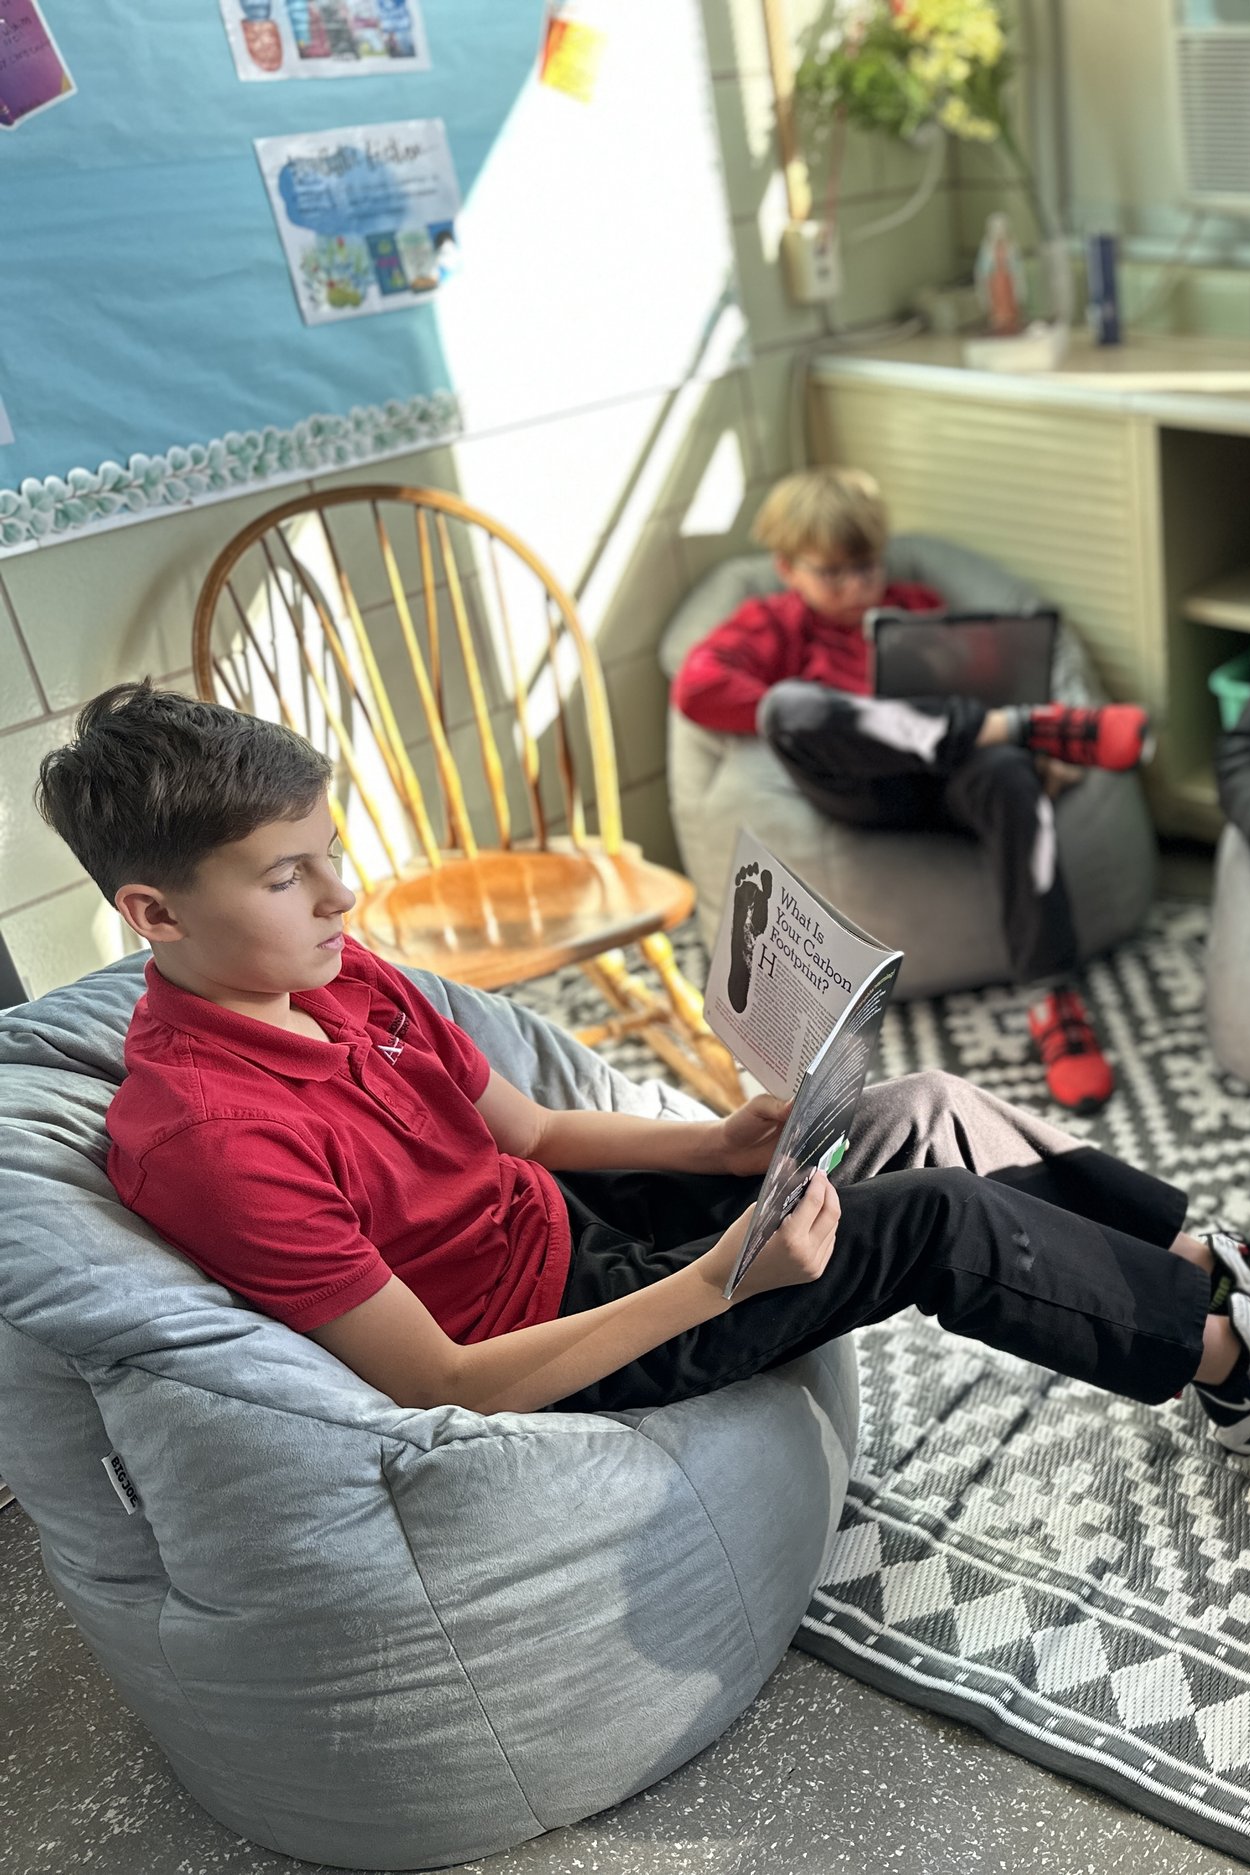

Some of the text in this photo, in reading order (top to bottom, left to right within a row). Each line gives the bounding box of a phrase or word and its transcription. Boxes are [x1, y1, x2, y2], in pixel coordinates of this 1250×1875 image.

[775, 906, 853, 994] Your Carbon
[781, 886, 825, 945] What Is
[769, 926, 830, 995] Footprint?
